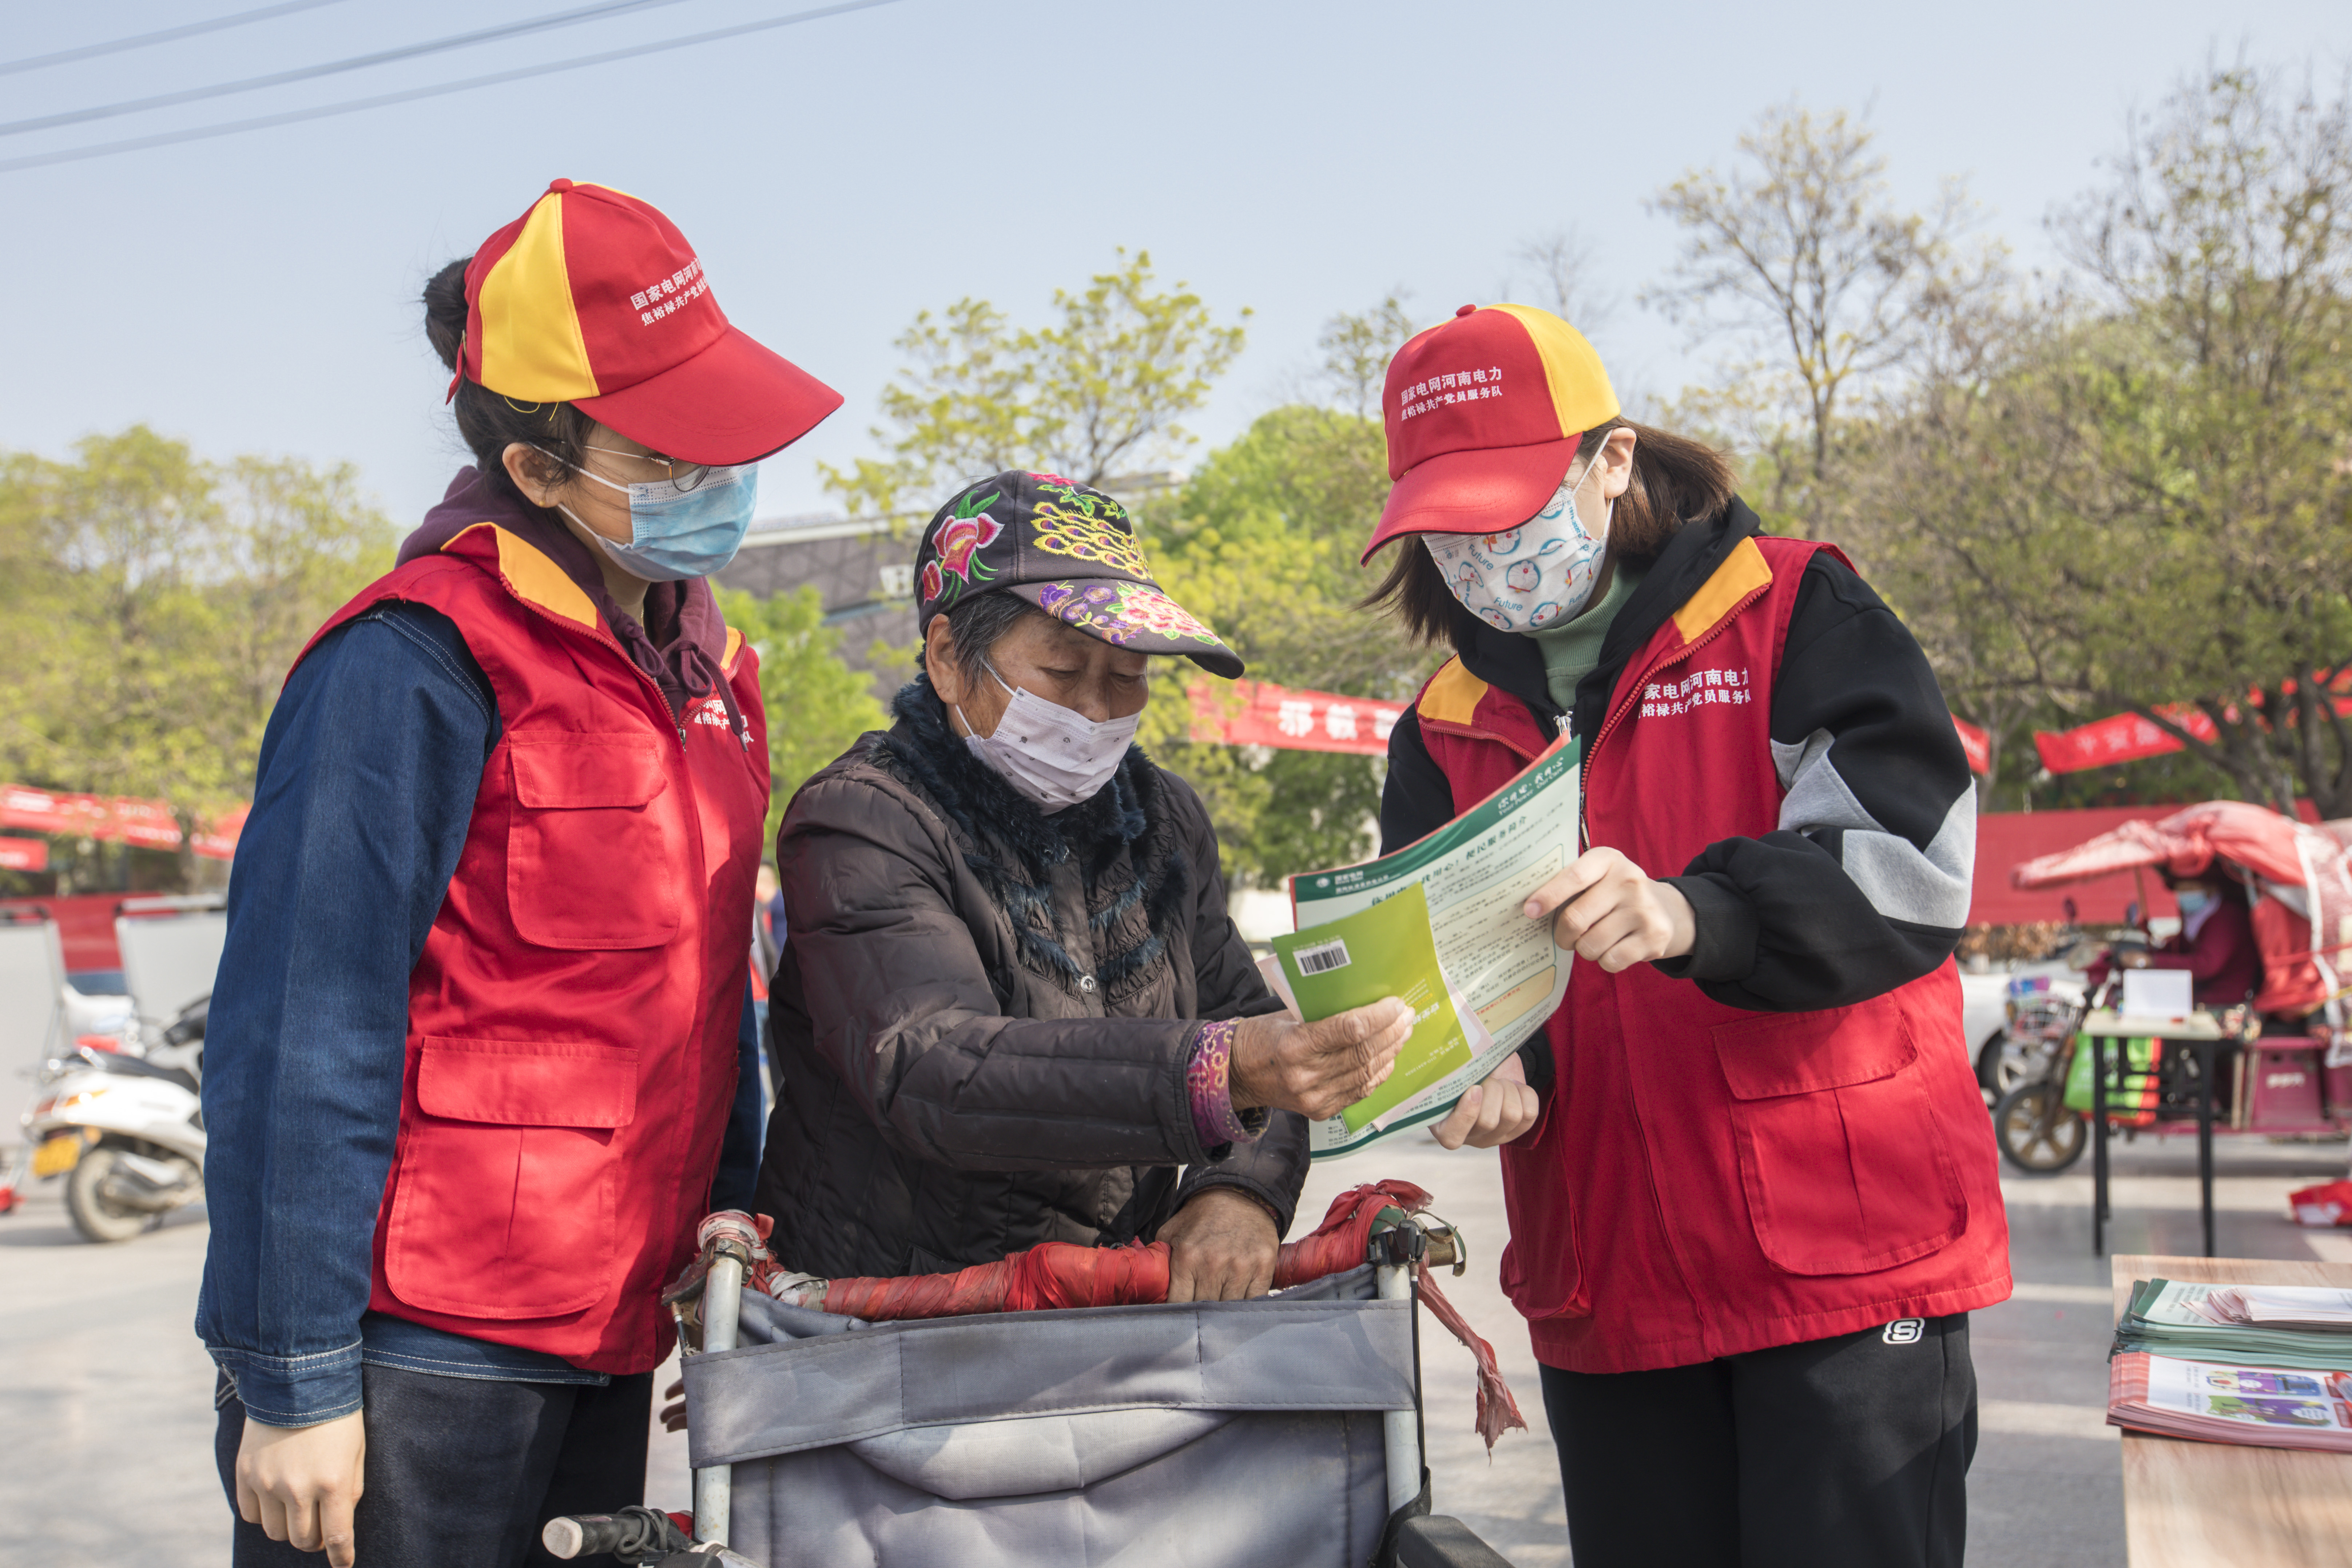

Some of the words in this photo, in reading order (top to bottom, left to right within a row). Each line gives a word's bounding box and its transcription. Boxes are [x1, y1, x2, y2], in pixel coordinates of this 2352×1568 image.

[1401, 366, 1502, 406] 国家电网河南电力
[1401, 385, 1503, 421] 焦裕禄共产党员服务队
[1468, 544, 1494, 570] Future
[1494, 597, 1523, 611] Future
[1638, 688, 1752, 719] 裕禄共产党员服务队
